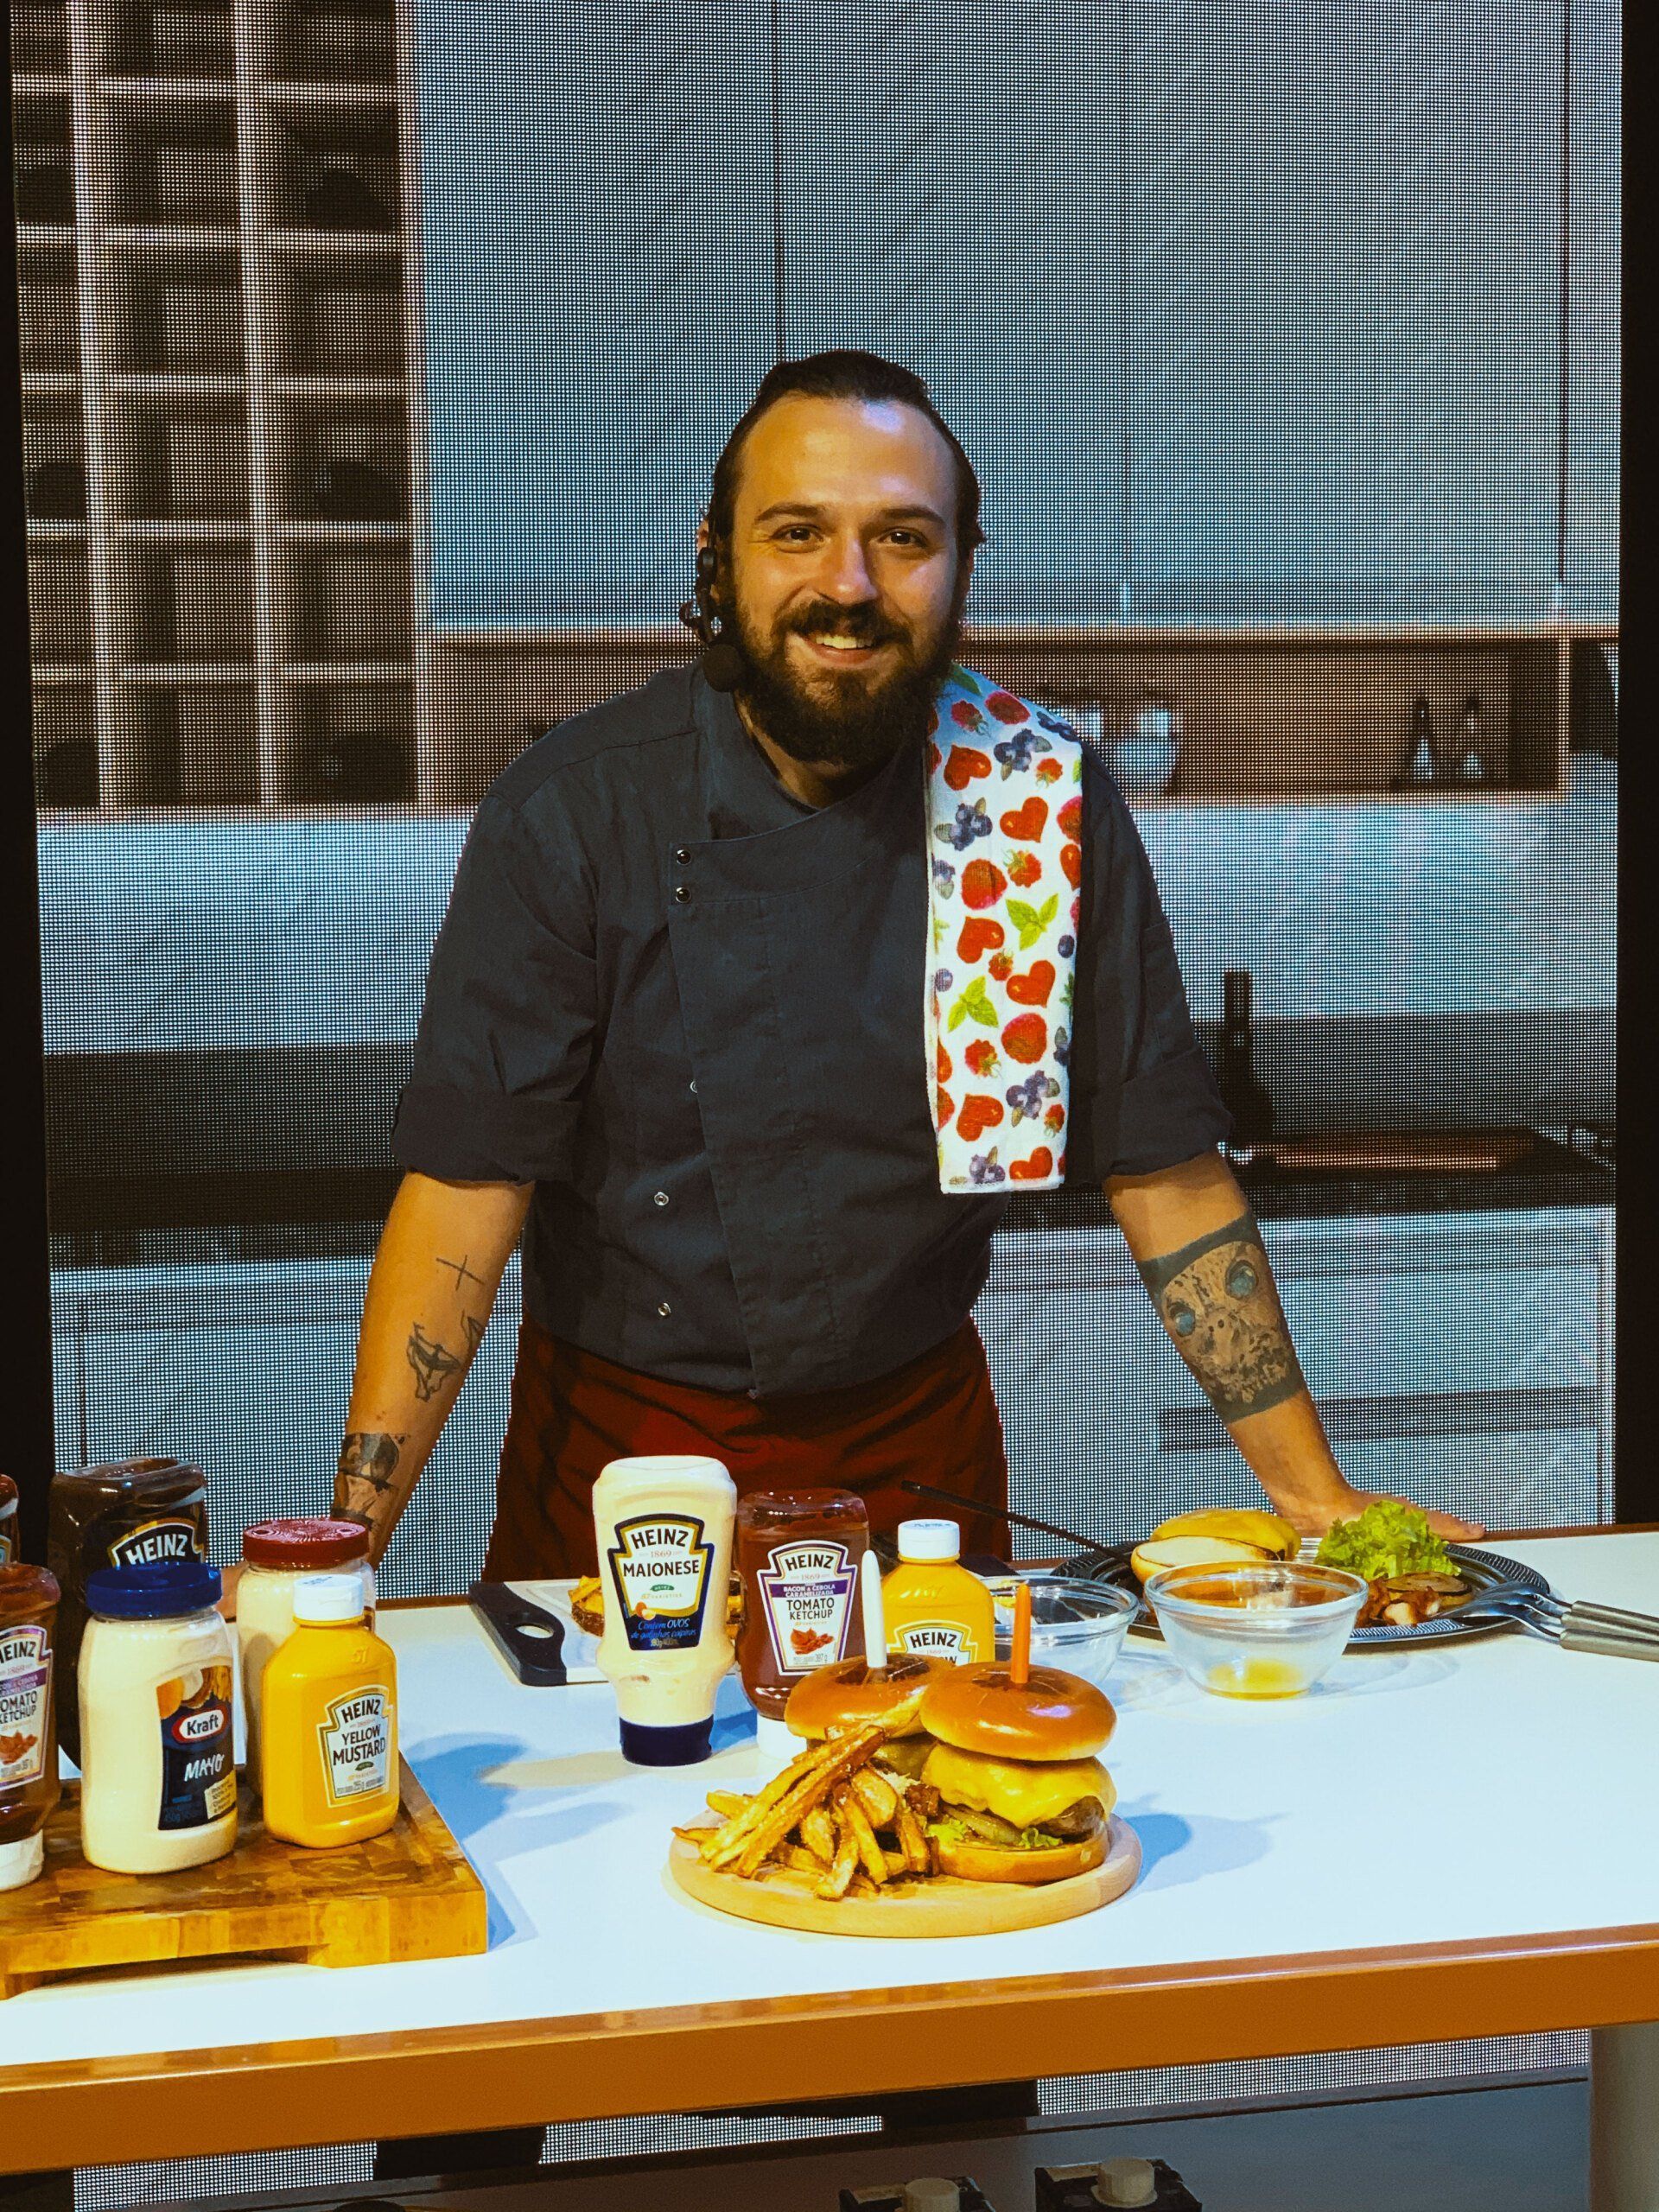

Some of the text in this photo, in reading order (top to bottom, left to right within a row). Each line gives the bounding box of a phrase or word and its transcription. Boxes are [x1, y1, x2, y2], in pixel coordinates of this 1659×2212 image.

[125, 1533, 188, 1565] HEINZ
[630, 1528, 689, 1549] HEINZ
[623, 1560, 700, 1577] MAIONESE
[785, 1554, 834, 1571] HEINZ
[786, 1598, 836, 1611] TOMATO
[790, 1609, 834, 1620] KETCHUP
[667, 1618, 691, 1628] OVOS
[909, 1631, 957, 1649] HEINZ
[0, 1690, 38, 1713] OMATO
[340, 1699, 381, 1724] HEINZ
[186, 1713, 219, 1735] Kraft
[341, 1724, 381, 1745] YELLOW
[333, 1737, 386, 1765] MUSTARD
[183, 1753, 225, 1782] MAYO
